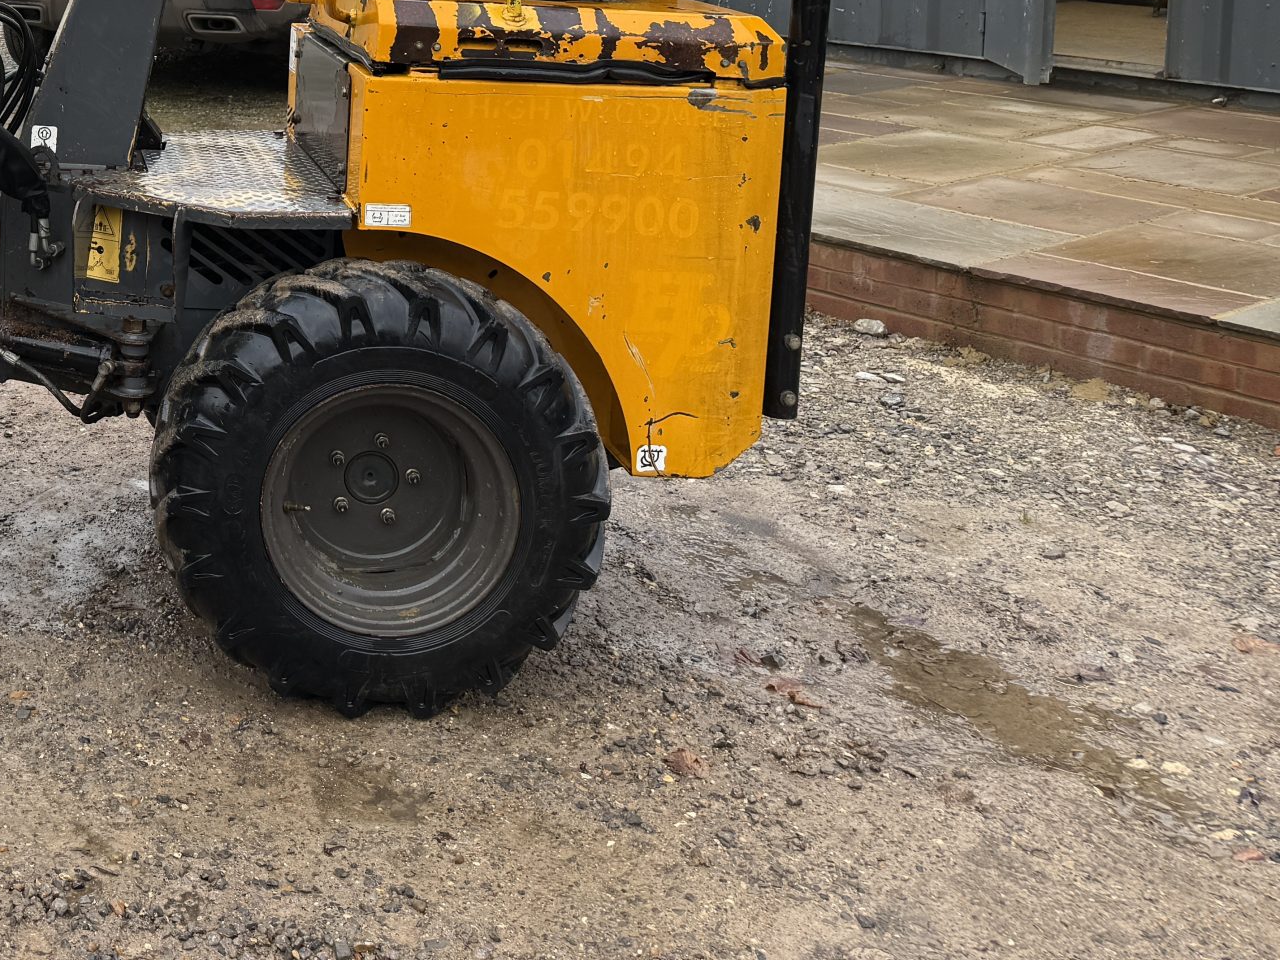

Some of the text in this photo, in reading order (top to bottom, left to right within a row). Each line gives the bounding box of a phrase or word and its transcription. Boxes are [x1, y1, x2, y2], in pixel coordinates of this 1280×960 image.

[466, 95, 551, 121] HIGH
[516, 136, 686, 181] 01494
[495, 187, 700, 239] 559900
